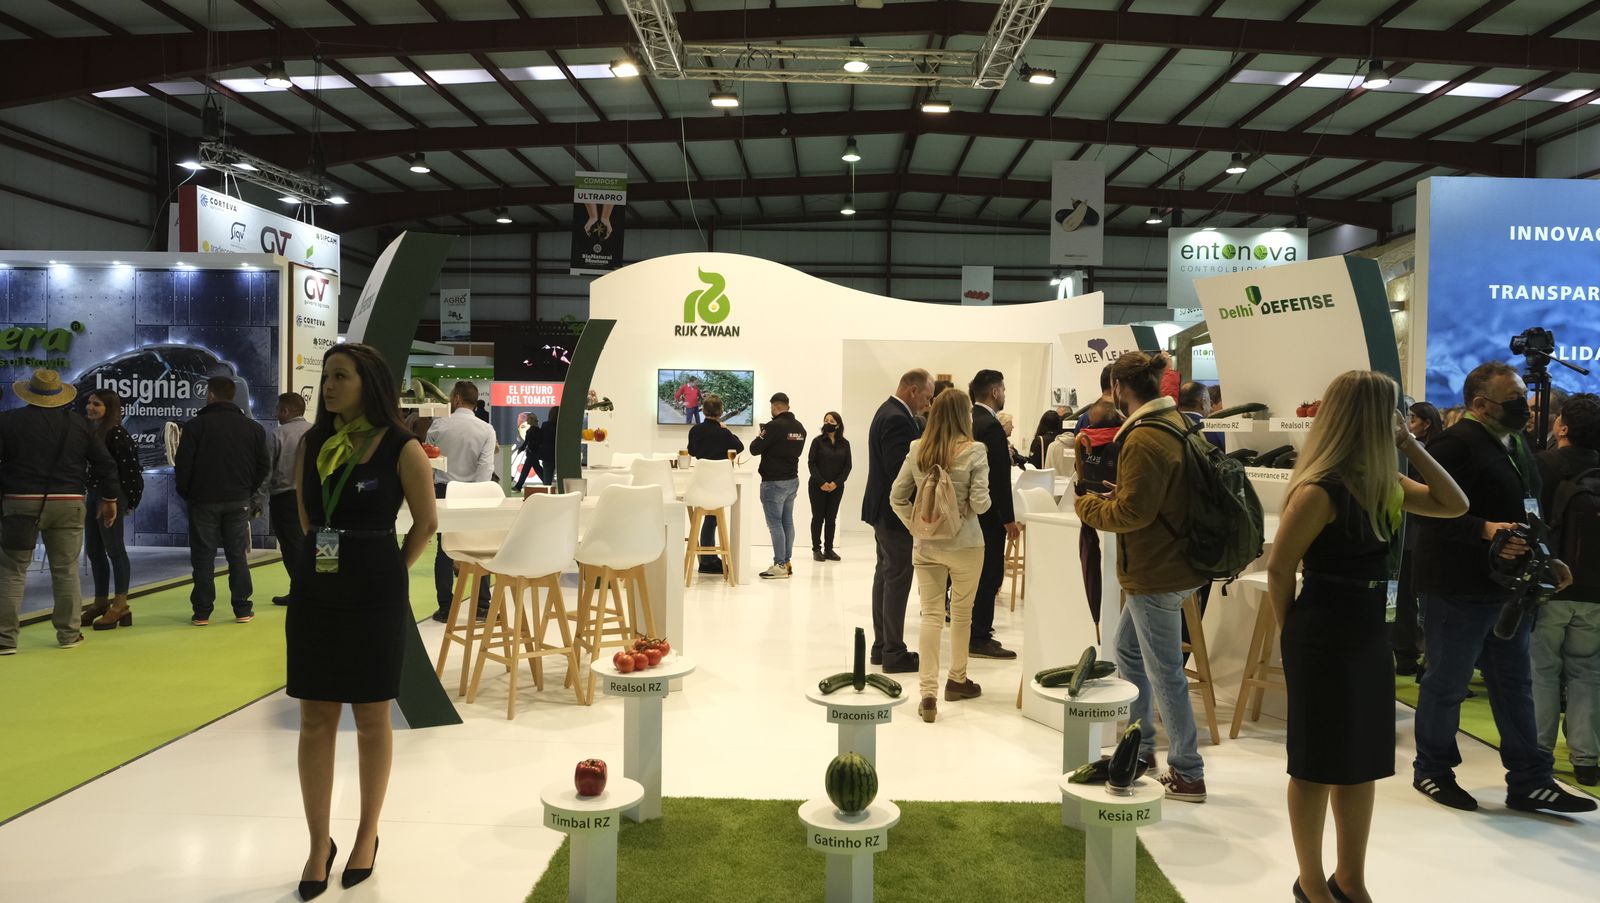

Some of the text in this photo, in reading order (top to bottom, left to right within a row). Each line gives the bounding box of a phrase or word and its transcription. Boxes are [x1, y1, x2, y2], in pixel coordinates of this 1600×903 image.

[584, 178, 618, 186] COMPOST
[578, 192, 623, 202] ULTRAPRO
[210, 197, 238, 212] CORTEVA
[1219, 304, 1254, 320] Delhi
[304, 317, 326, 327] CORTEVA
[674, 325, 740, 337] RIJK ZWAAN
[1074, 352, 1099, 364] BLUE
[1549, 346, 1600, 361] LID
[96, 373, 191, 403] Insignia
[509, 385, 553, 395] EL FUTURO
[506, 396, 556, 405] DEL TOMATE
[120, 406, 182, 417] eíblemente
[1206, 421, 1240, 429] Maritimo RZ
[1281, 421, 1304, 429] Realsol
[1244, 470, 1290, 480] erseverance RZ
[610, 682, 662, 692] Realsol RZ
[832, 709, 889, 720] Draconis RZ
[1068, 705, 1128, 718] Maritimo RZ
[1098, 808, 1151, 822] Kesia RZ
[551, 813, 611, 829] Timbal RZ
[814, 833, 880, 848] Gatinho RZ
